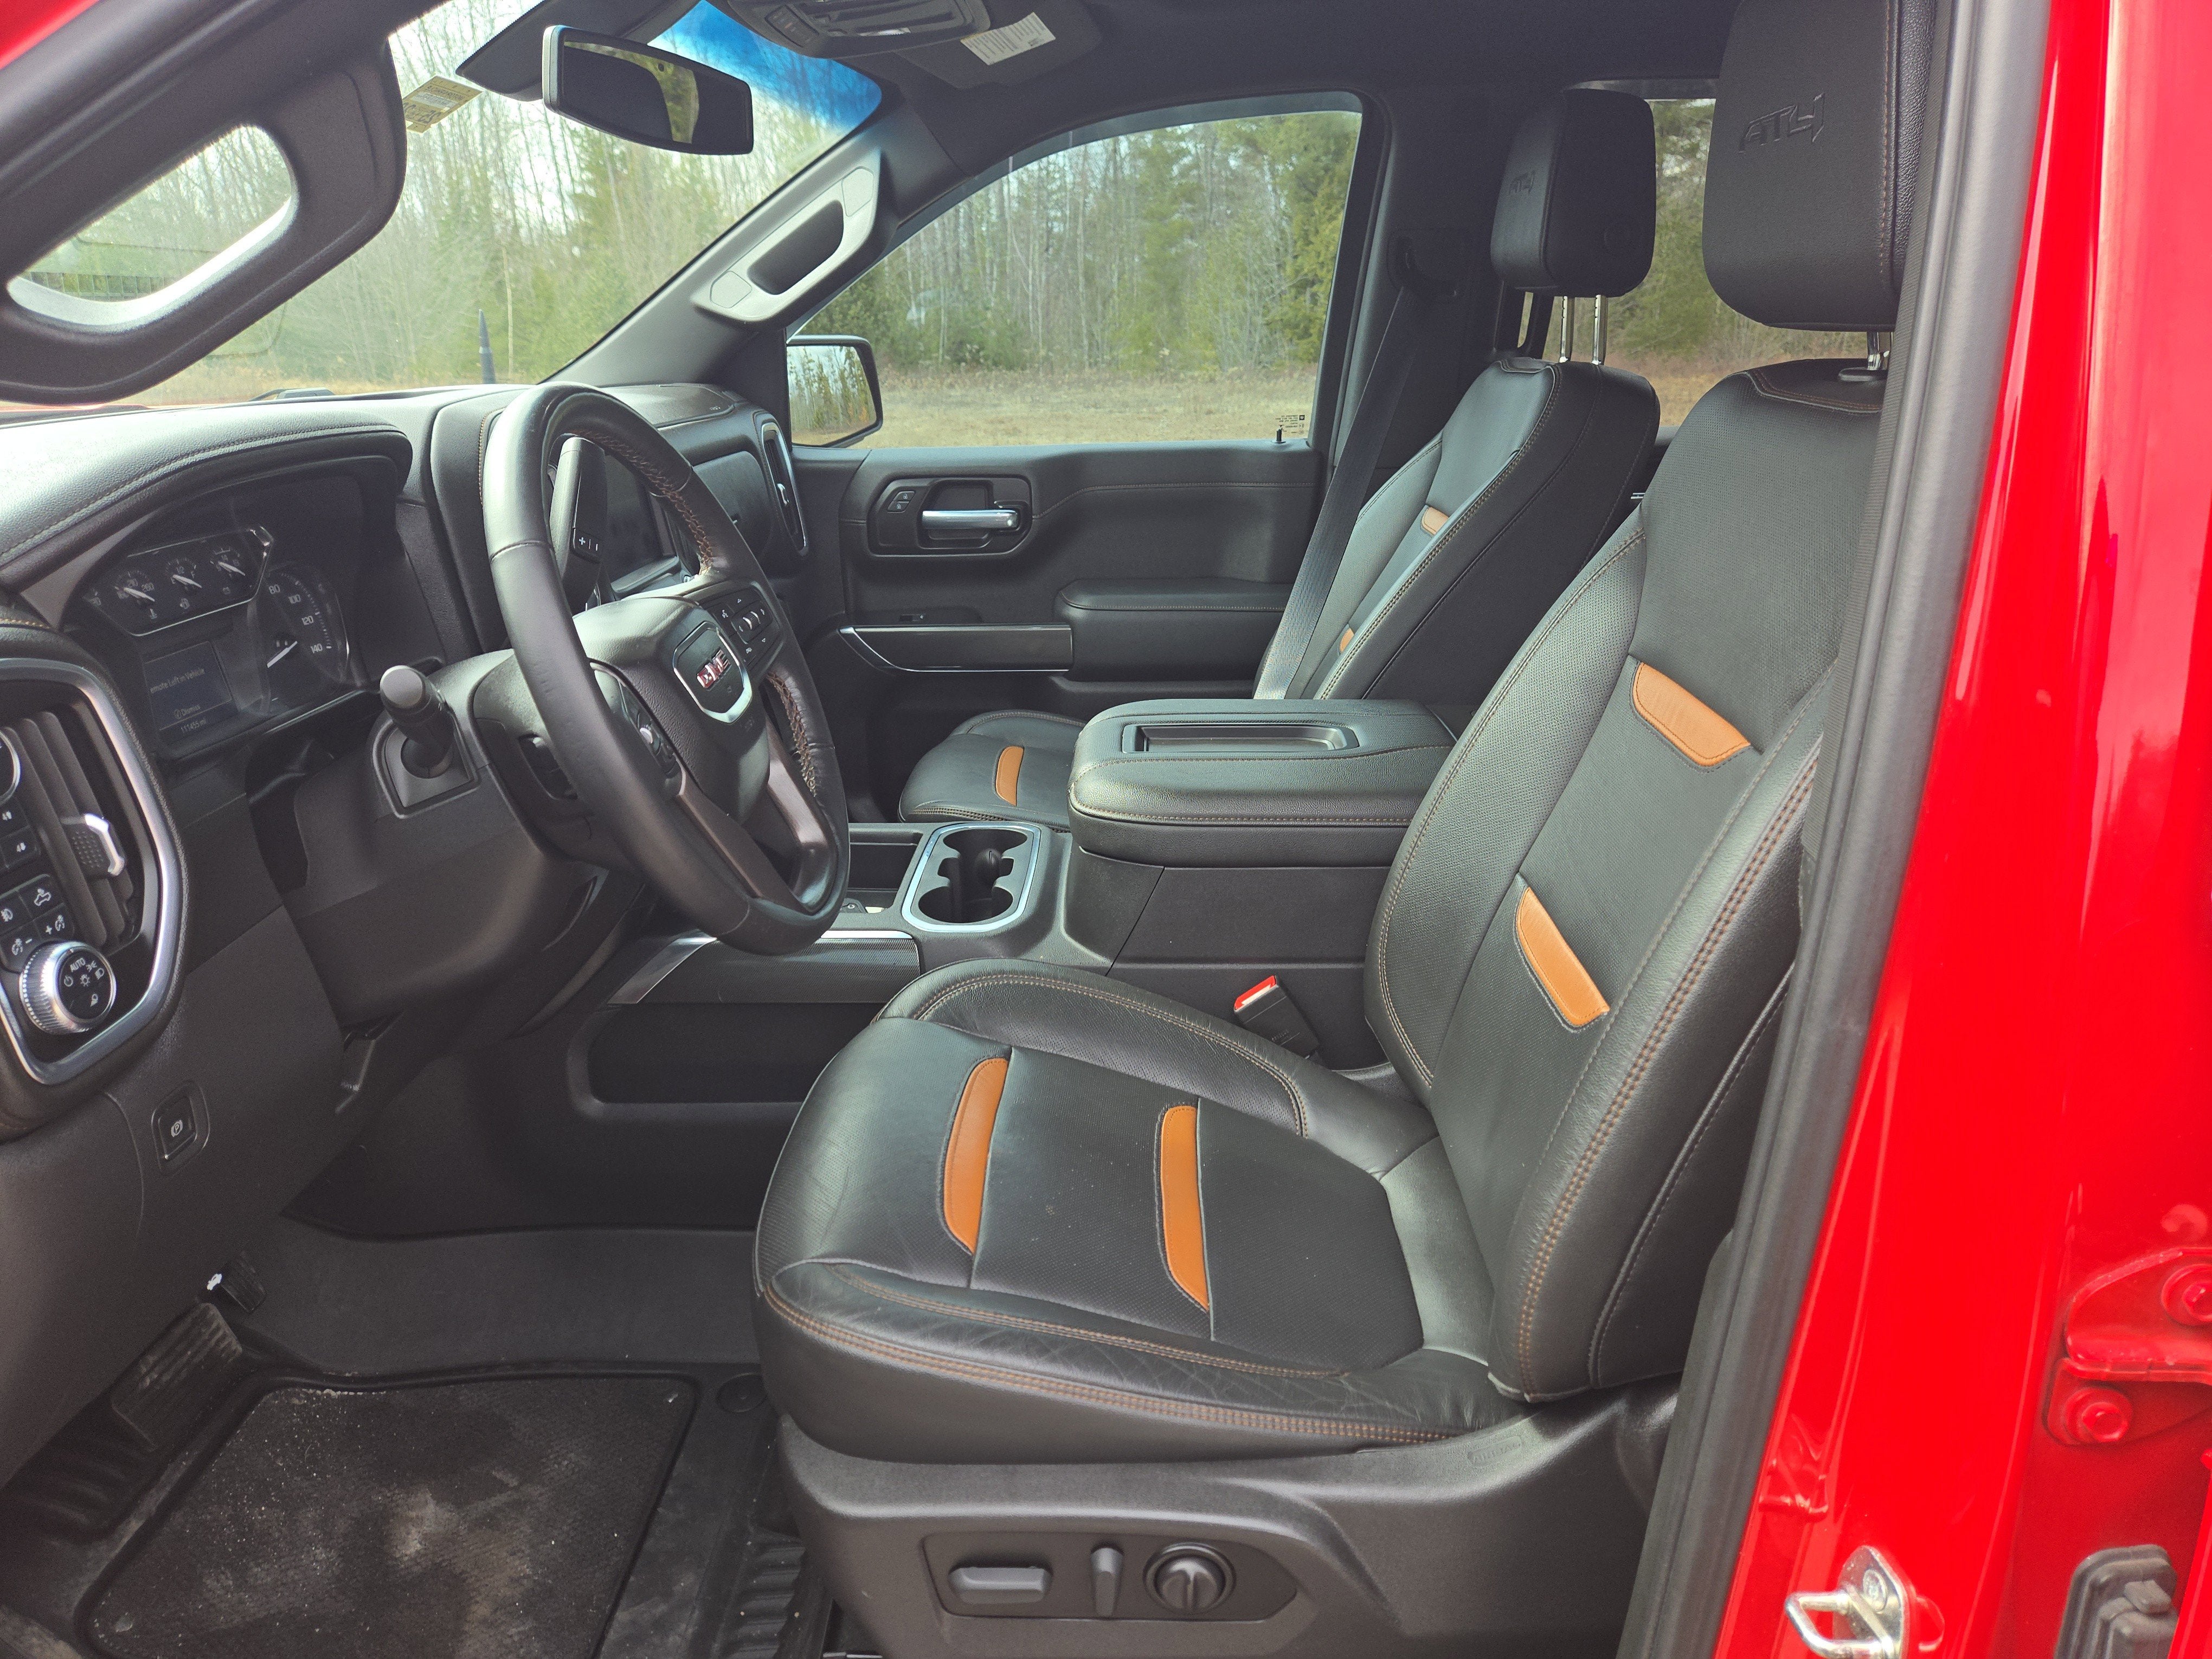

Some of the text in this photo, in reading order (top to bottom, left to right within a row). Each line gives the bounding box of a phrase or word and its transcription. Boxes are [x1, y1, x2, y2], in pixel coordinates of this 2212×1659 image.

[1738, 92, 1825, 154] AT4
[141, 582, 155, 592] 260
[269, 584, 280, 594] 80
[288, 594, 301, 604] 100
[301, 615, 314, 626] 120
[310, 643, 323, 654] 140
[697, 649, 731, 689] GMC
[70, 957, 86, 973] AUTO
